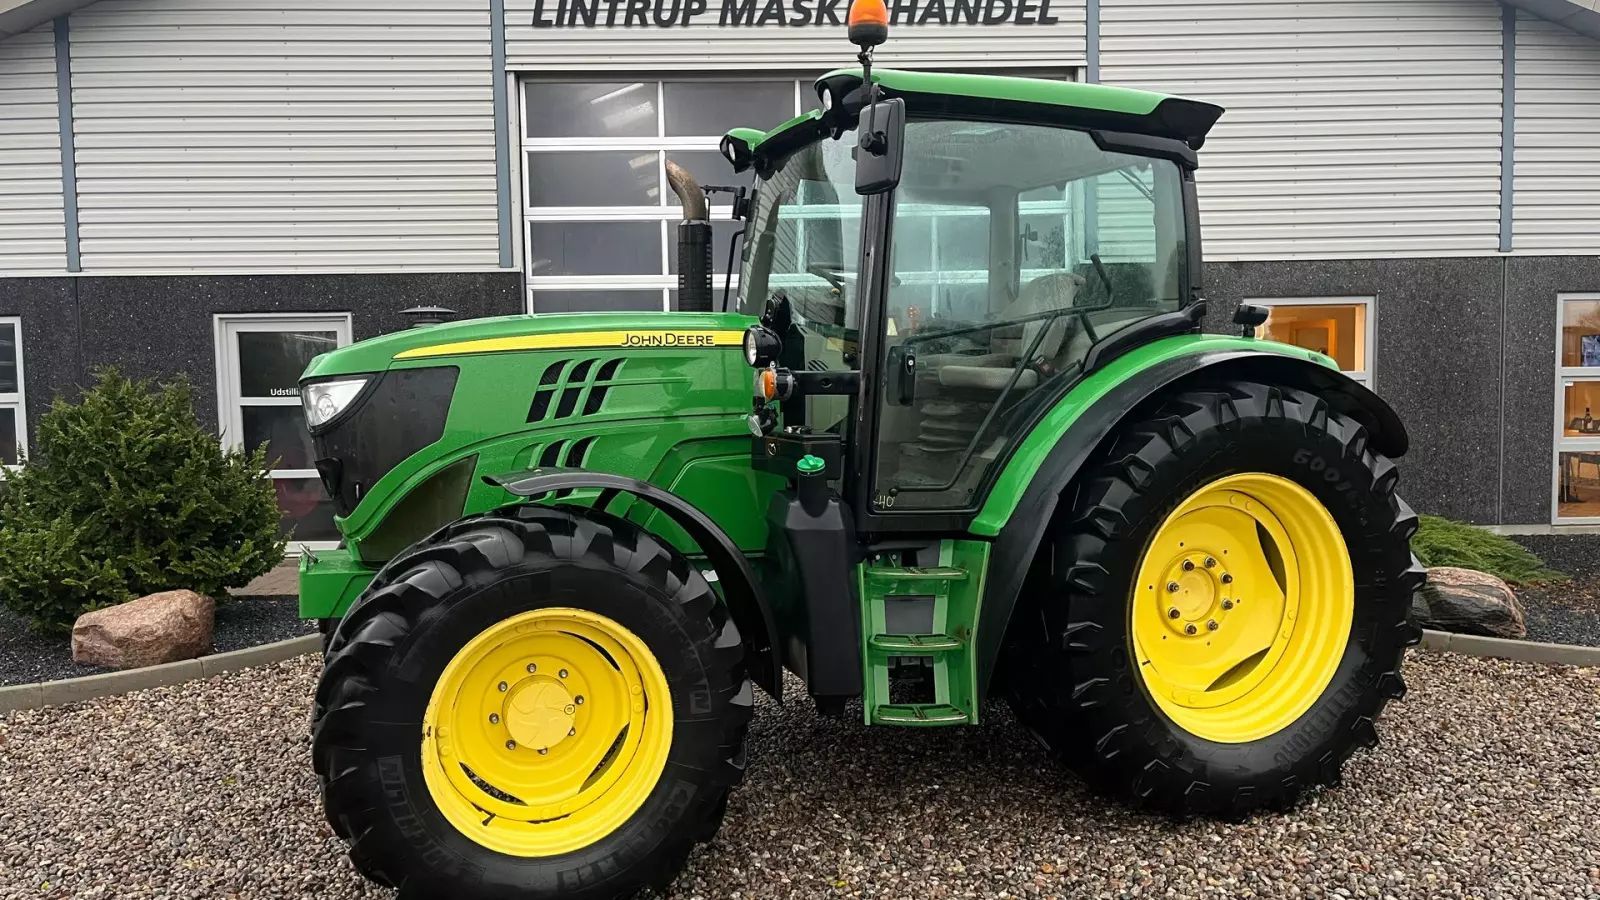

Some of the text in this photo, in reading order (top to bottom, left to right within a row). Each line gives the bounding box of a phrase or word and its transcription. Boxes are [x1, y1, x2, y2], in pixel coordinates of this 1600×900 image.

[531, 0, 708, 28] LINTRUP
[621, 333, 714, 346] JOHN DEERE
